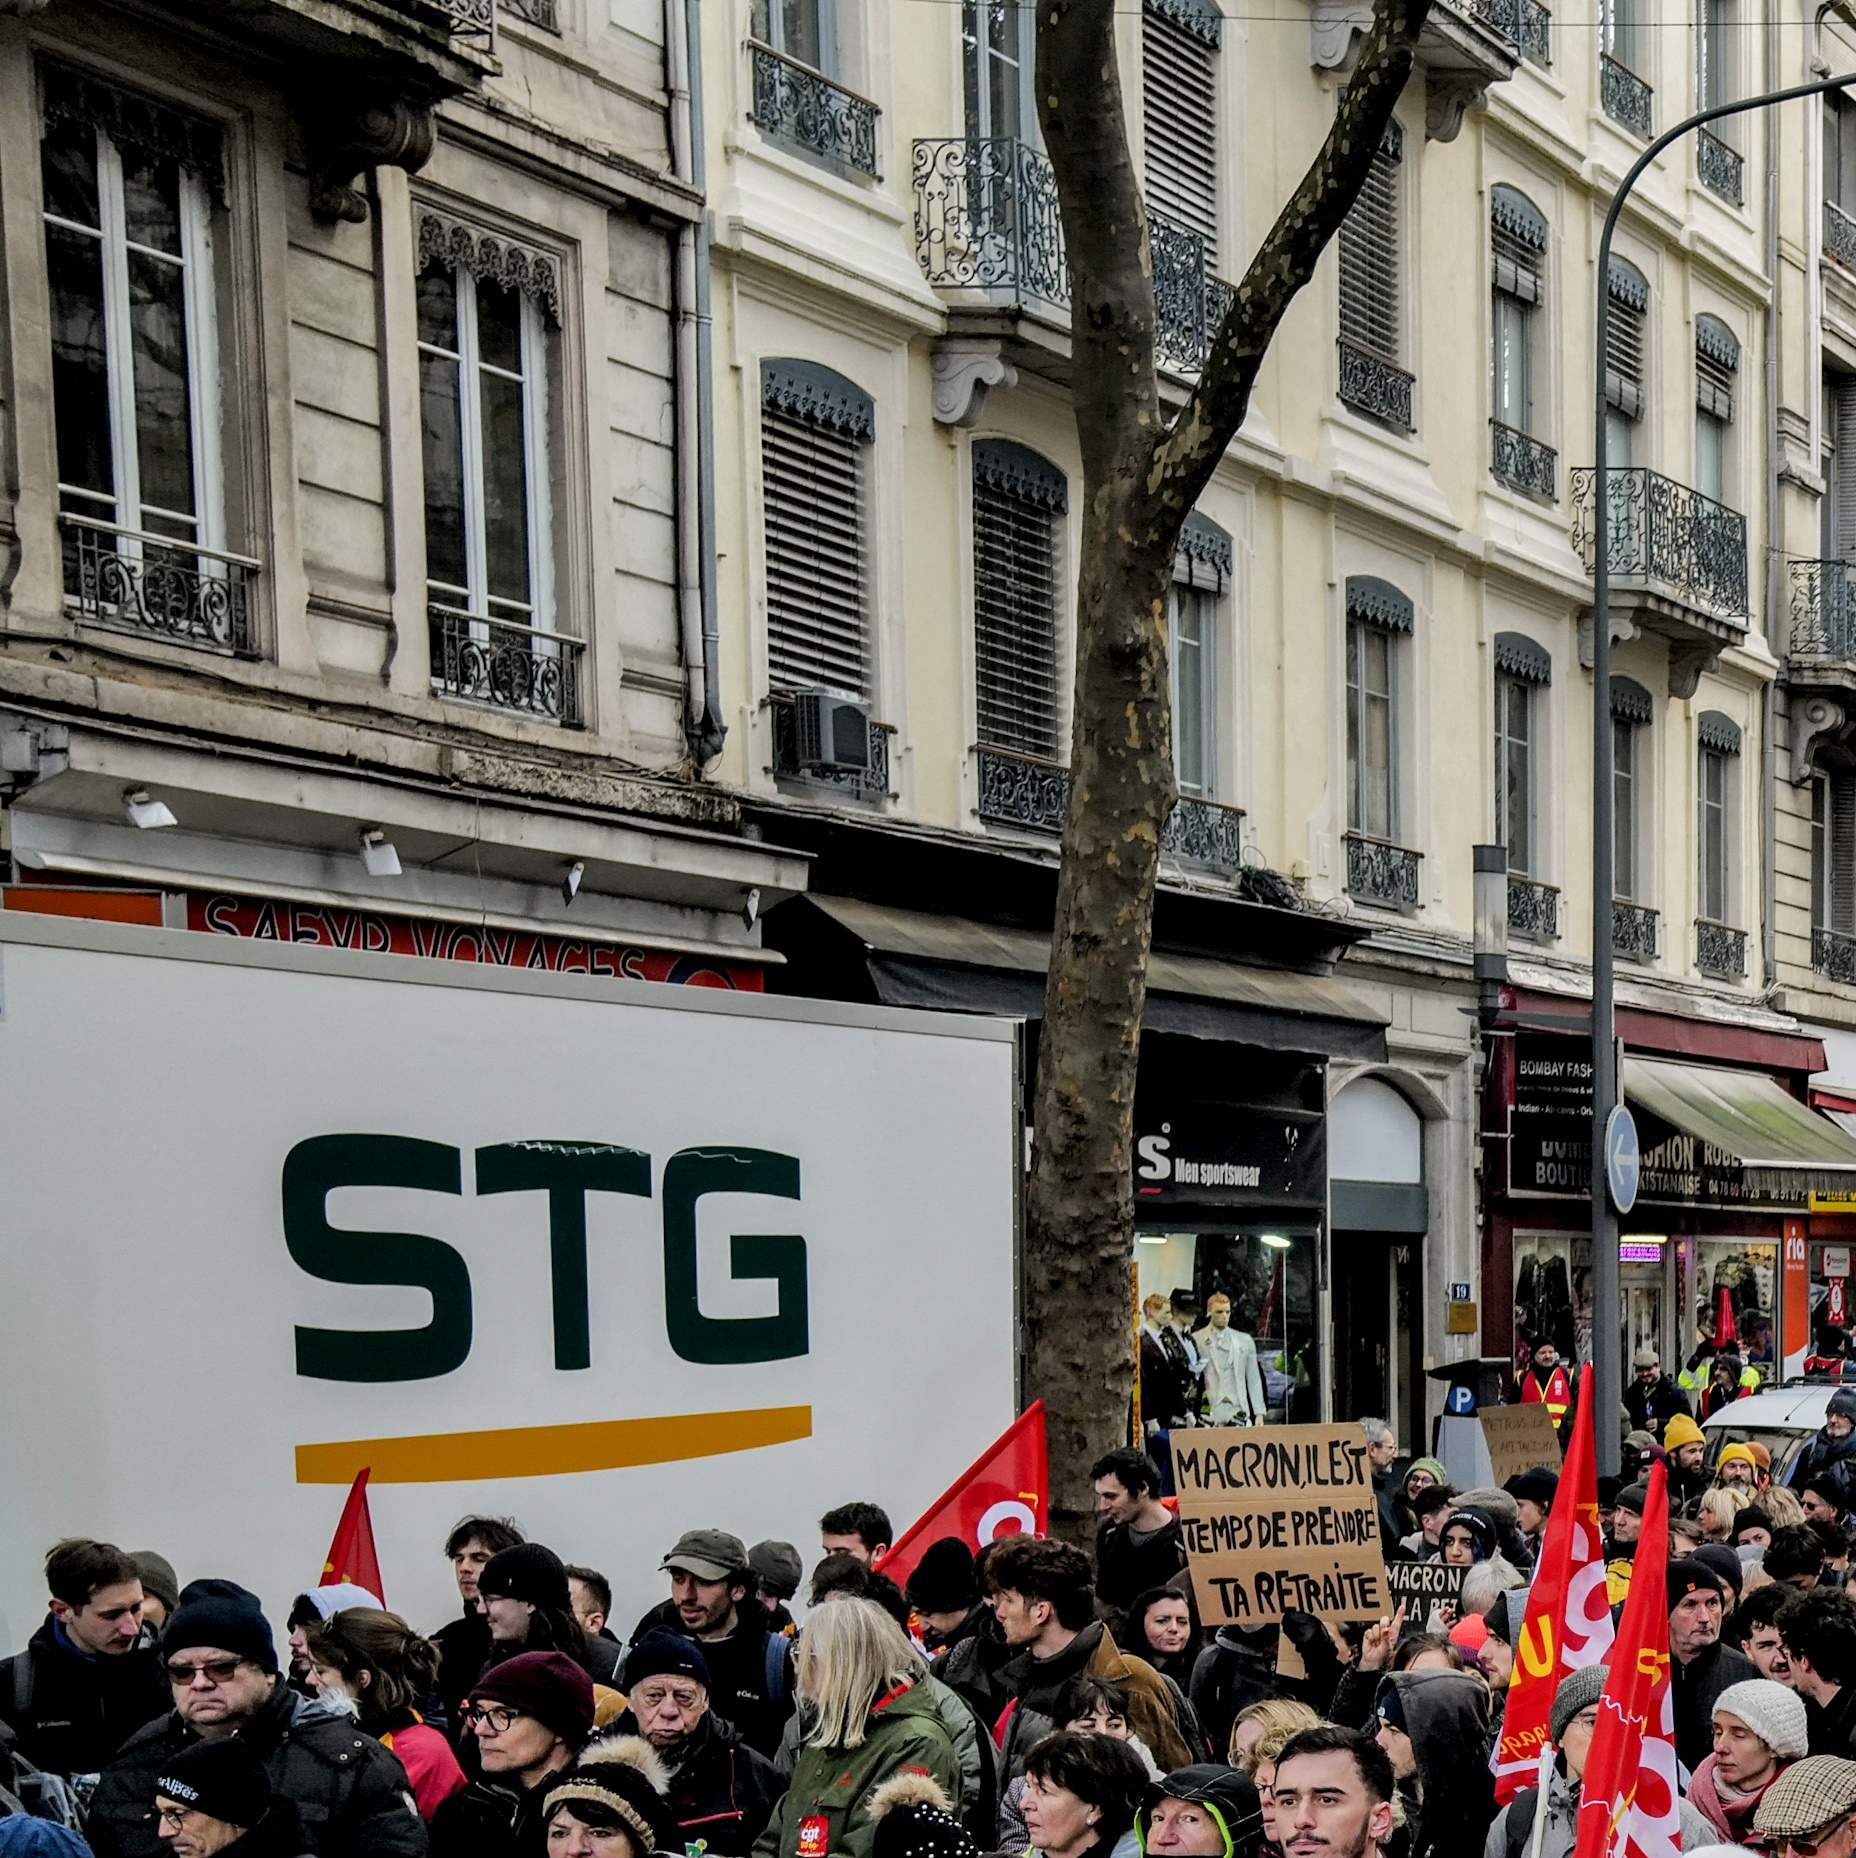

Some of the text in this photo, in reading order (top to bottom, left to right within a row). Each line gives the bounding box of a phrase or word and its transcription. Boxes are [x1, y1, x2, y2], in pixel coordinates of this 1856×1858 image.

[1519, 1060, 1564, 1078] BOMBAY
[1518, 1103, 1540, 1113] Indian
[1175, 1158, 1261, 1187] Men sportswear
[1787, 1226, 1805, 1260] ria
[283, 1133, 811, 1383] STG
[1456, 1285, 1467, 1299] 19
[1182, 1505, 1377, 1553] TEMPS DE PRENDRE
[1209, 1562, 1380, 1618] TA RETRAITE
[1386, 1565, 1460, 1592] MACRON
[801, 1826, 819, 1842] cgt
